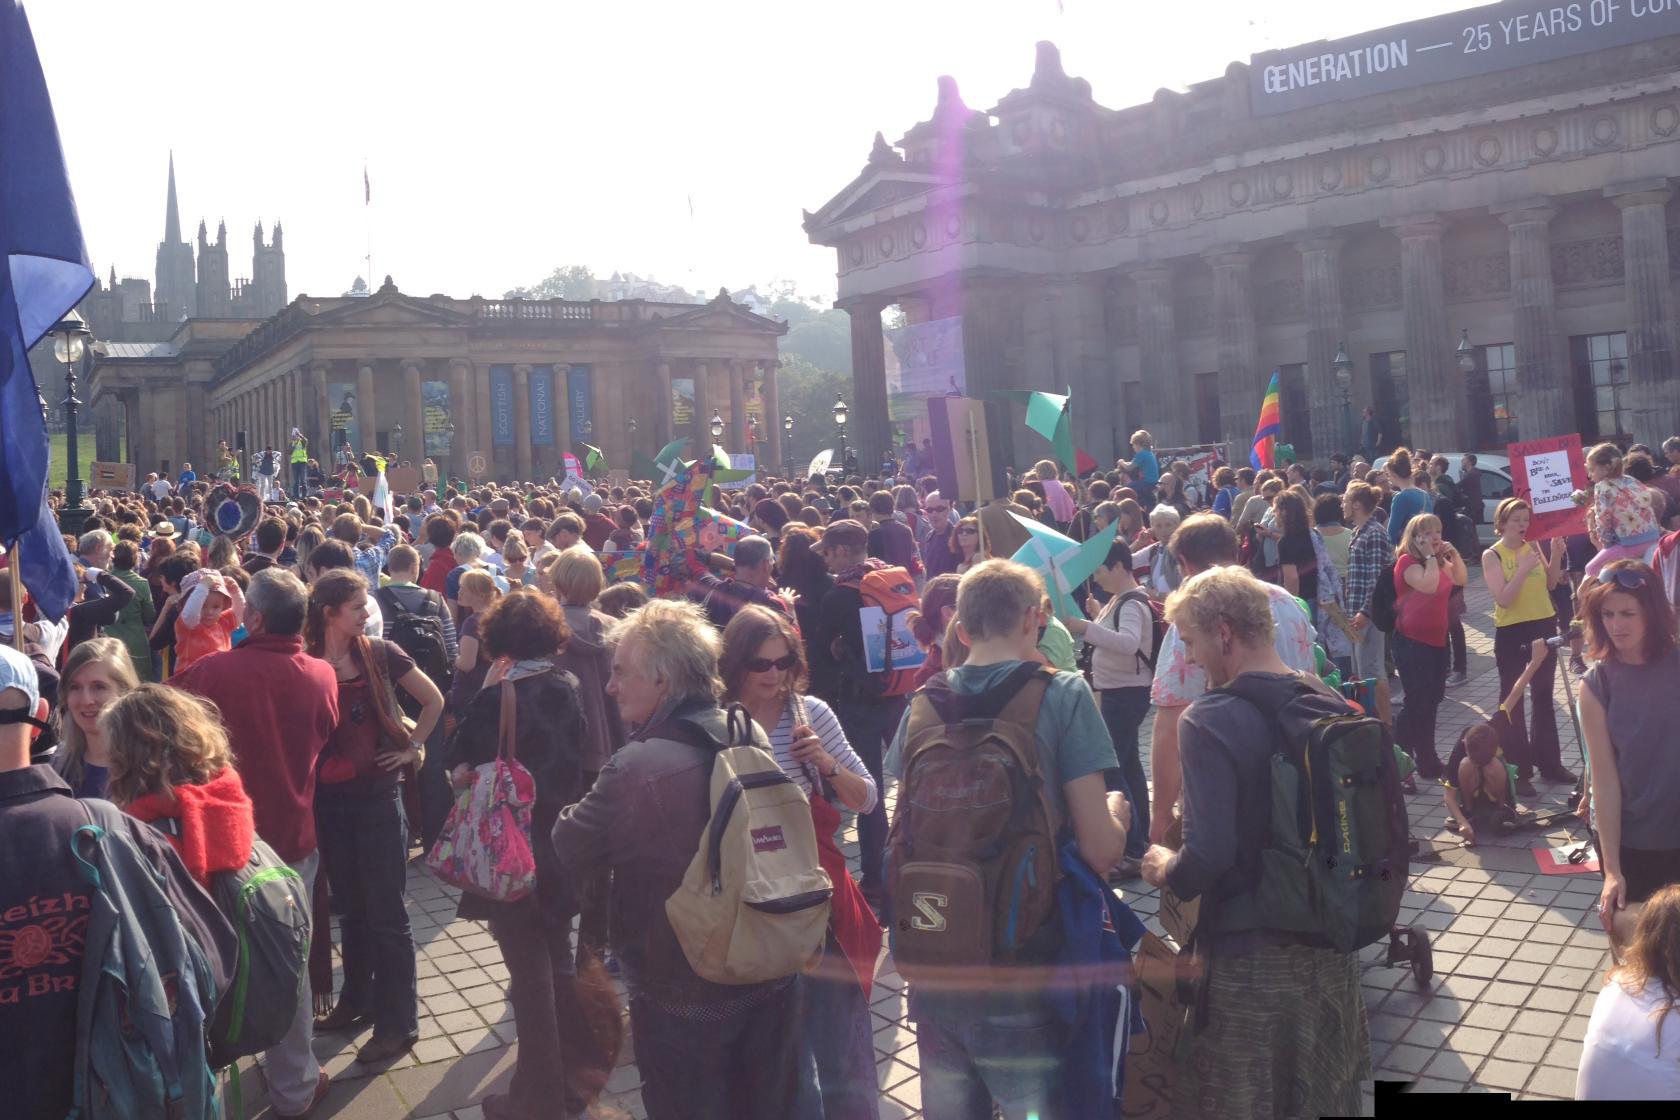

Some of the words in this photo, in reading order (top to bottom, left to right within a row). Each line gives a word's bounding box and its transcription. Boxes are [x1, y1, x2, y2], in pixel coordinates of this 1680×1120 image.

[1462, 23, 1492, 54] 25
[1499, 3, 1582, 45] YEARS
[1590, 0, 1620, 27] OF
[497, 383, 508, 435] SCOTTISH
[536, 380, 546, 436] NATIONAL
[576, 389, 585, 434] GALLERY
